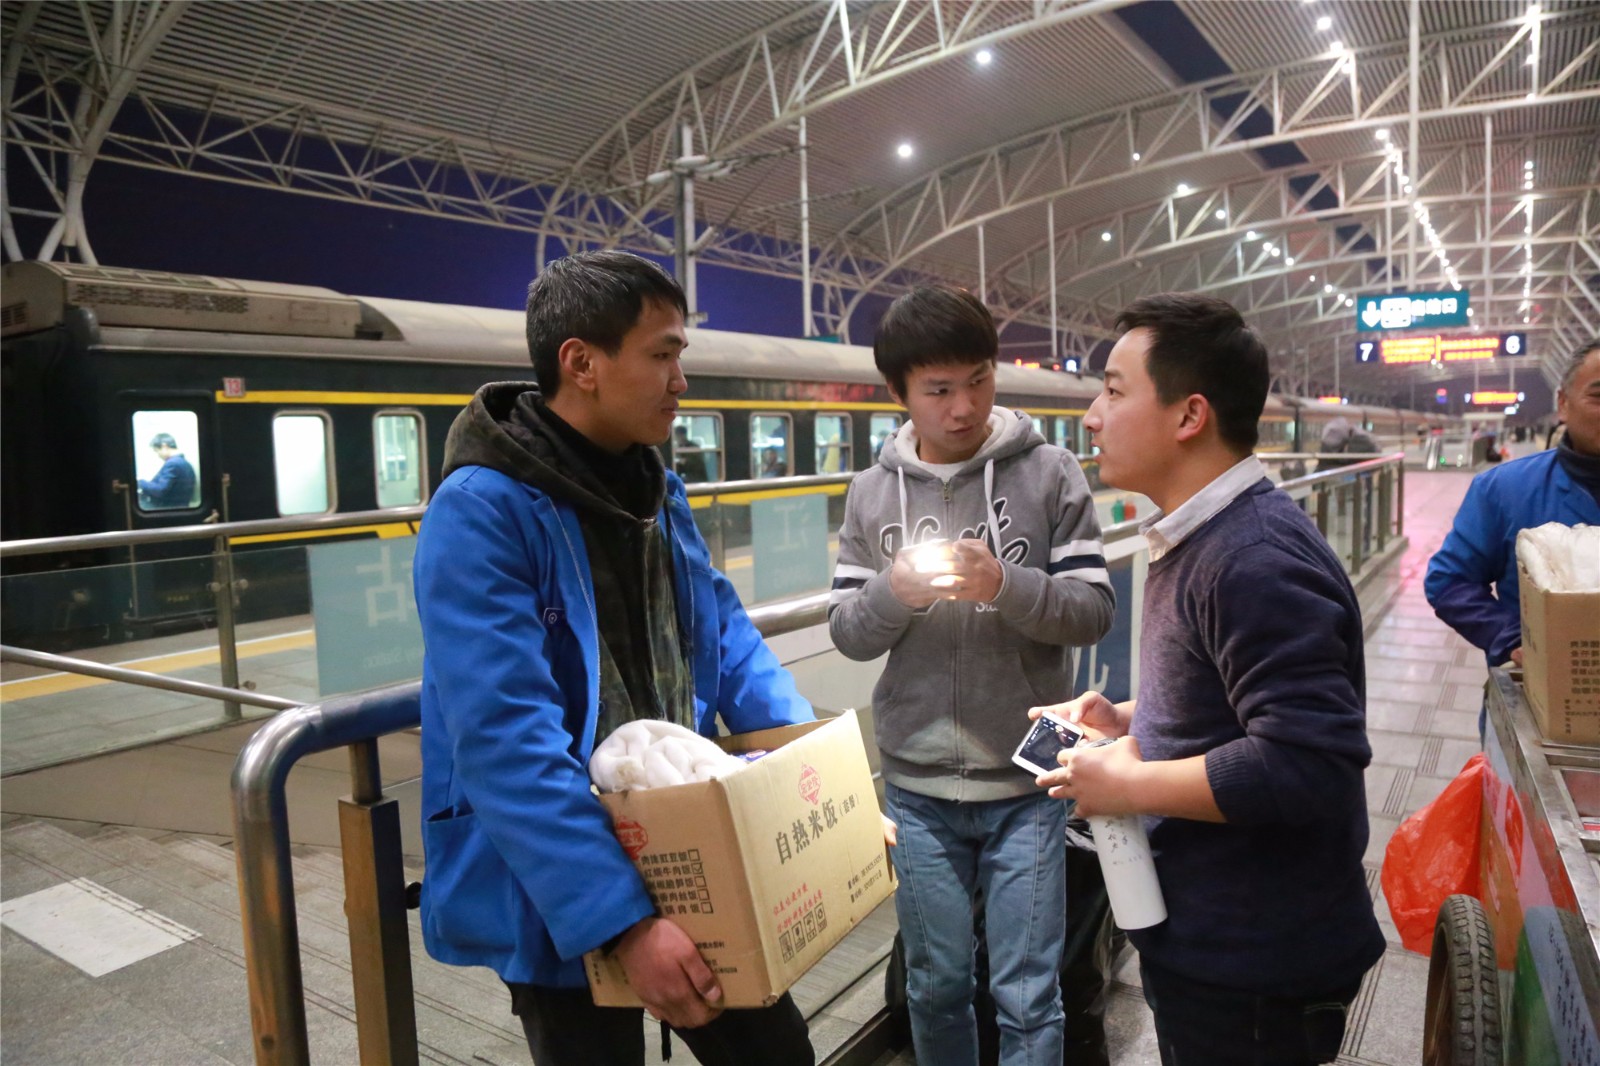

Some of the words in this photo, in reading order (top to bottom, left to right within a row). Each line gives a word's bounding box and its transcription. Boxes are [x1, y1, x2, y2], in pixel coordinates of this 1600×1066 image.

[1360, 343, 1373, 361] 7
[775, 797, 839, 865] 自热米饭
[643, 865, 692, 879] 红烧牛肉饭
